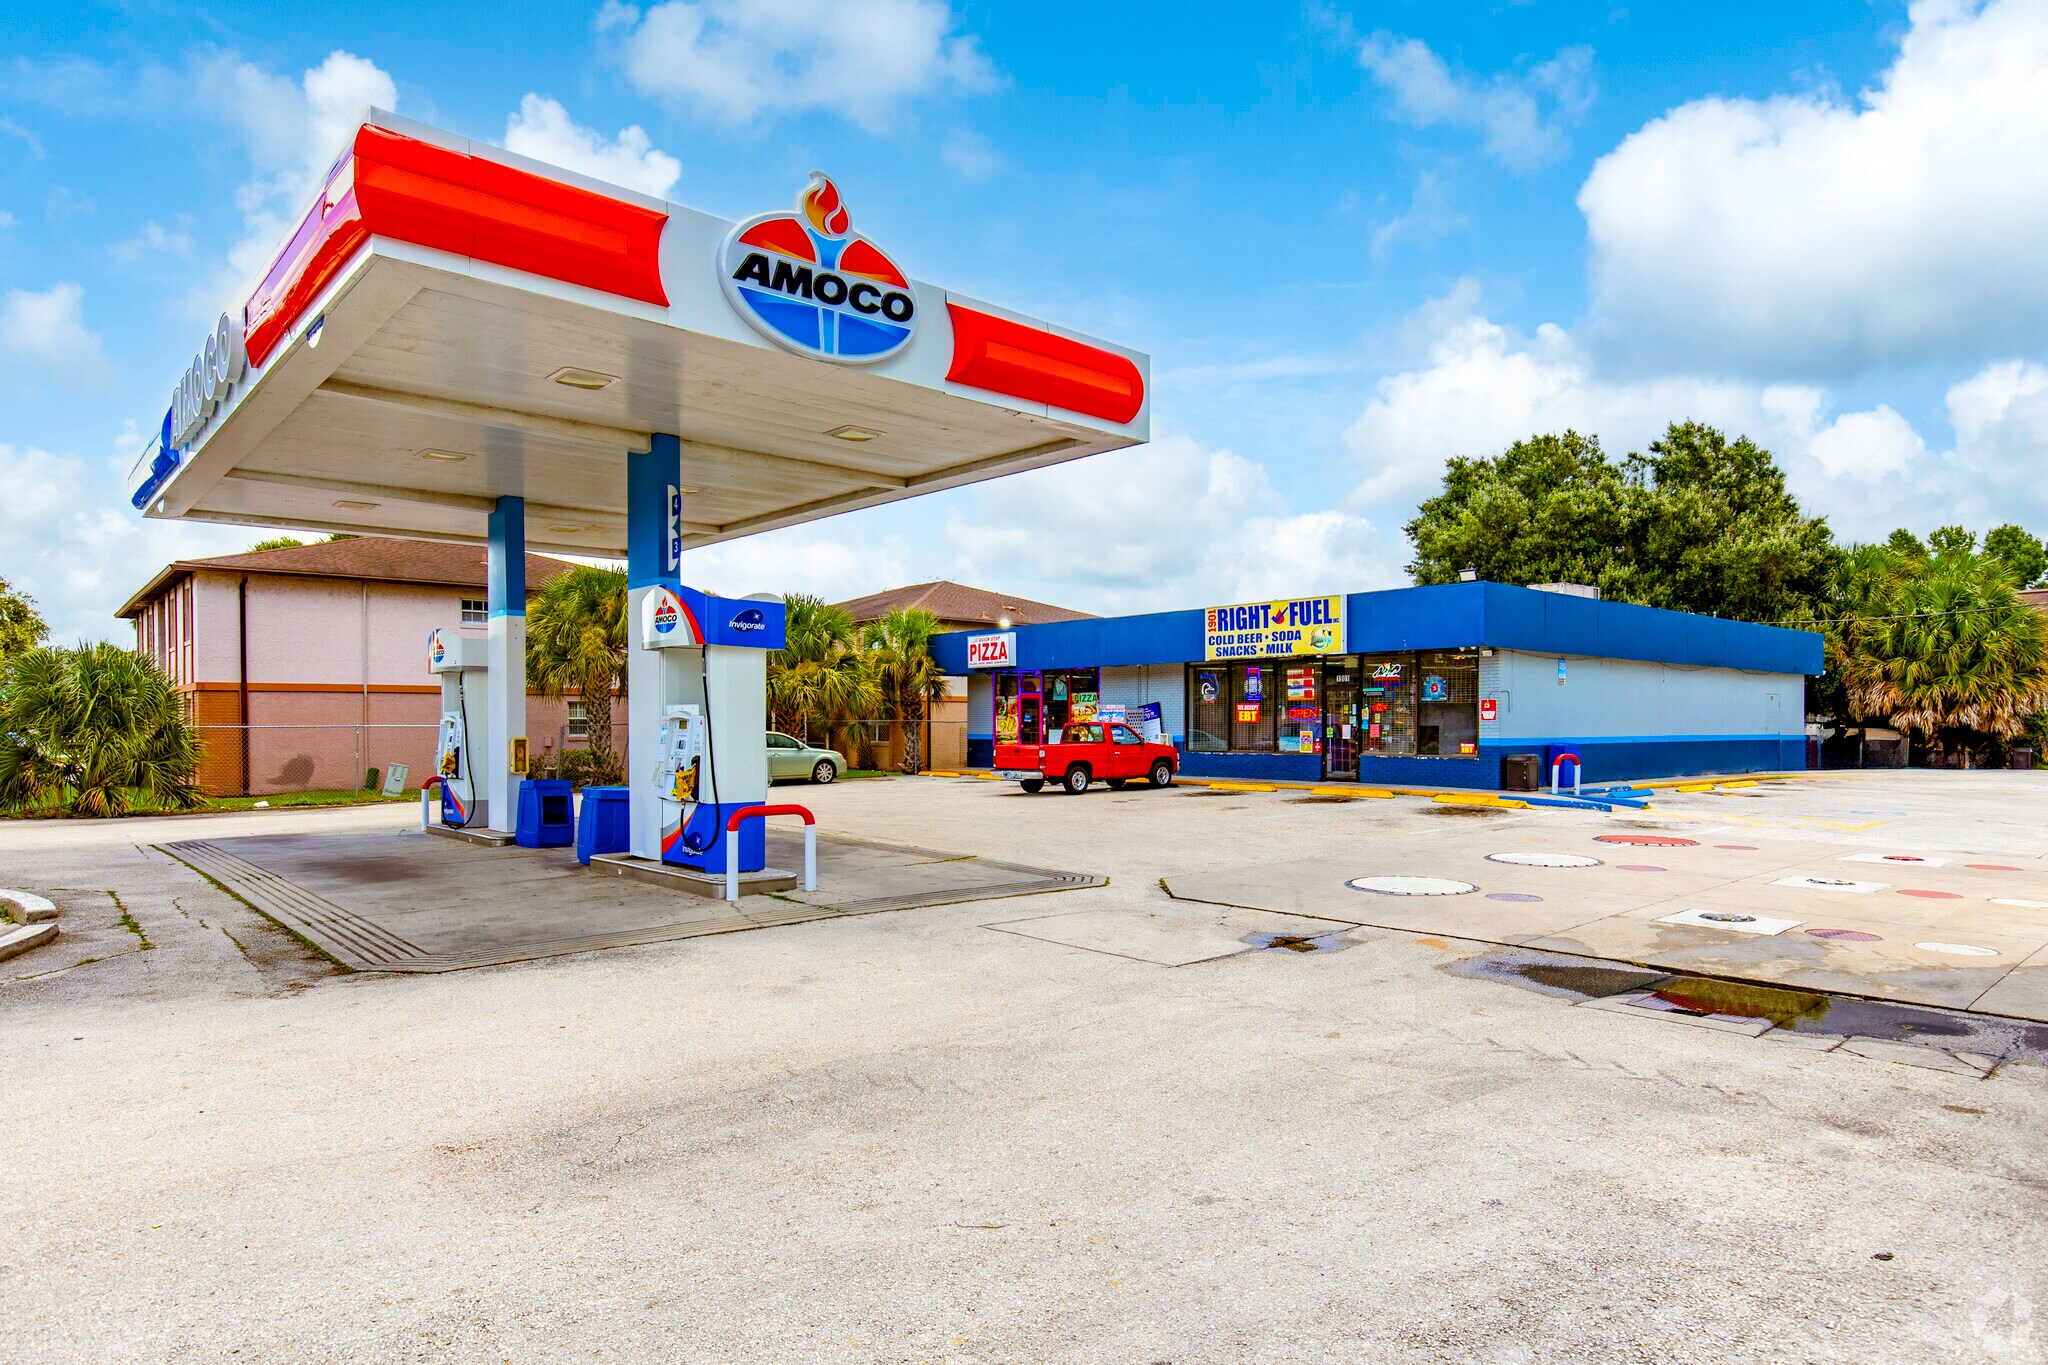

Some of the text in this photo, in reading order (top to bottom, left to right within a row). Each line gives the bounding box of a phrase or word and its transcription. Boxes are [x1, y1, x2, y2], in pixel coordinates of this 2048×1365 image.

[732, 252, 914, 323] AMOCO
[170, 312, 236, 450] AMOCO
[673, 498, 678, 509] 4
[673, 541, 679, 553] 3
[654, 614, 677, 624] AMOCO
[1207, 609, 1216, 632] 1901
[1217, 604, 1271, 632] RIGHT
[1289, 599, 1332, 626] FUEL
[728, 620, 765, 631] Invigorate
[1208, 635, 1235, 646] COLD
[1237, 633, 1263, 644] BEER
[1271, 630, 1302, 642] SODA
[969, 641, 1008, 662] PIZZA
[1215, 643, 1293, 657] SNACKS MILK
[1074, 694, 1098, 703] PIZZA
[1239, 711, 1257, 721] EBT
[1289, 708, 1317, 718] OPEN
